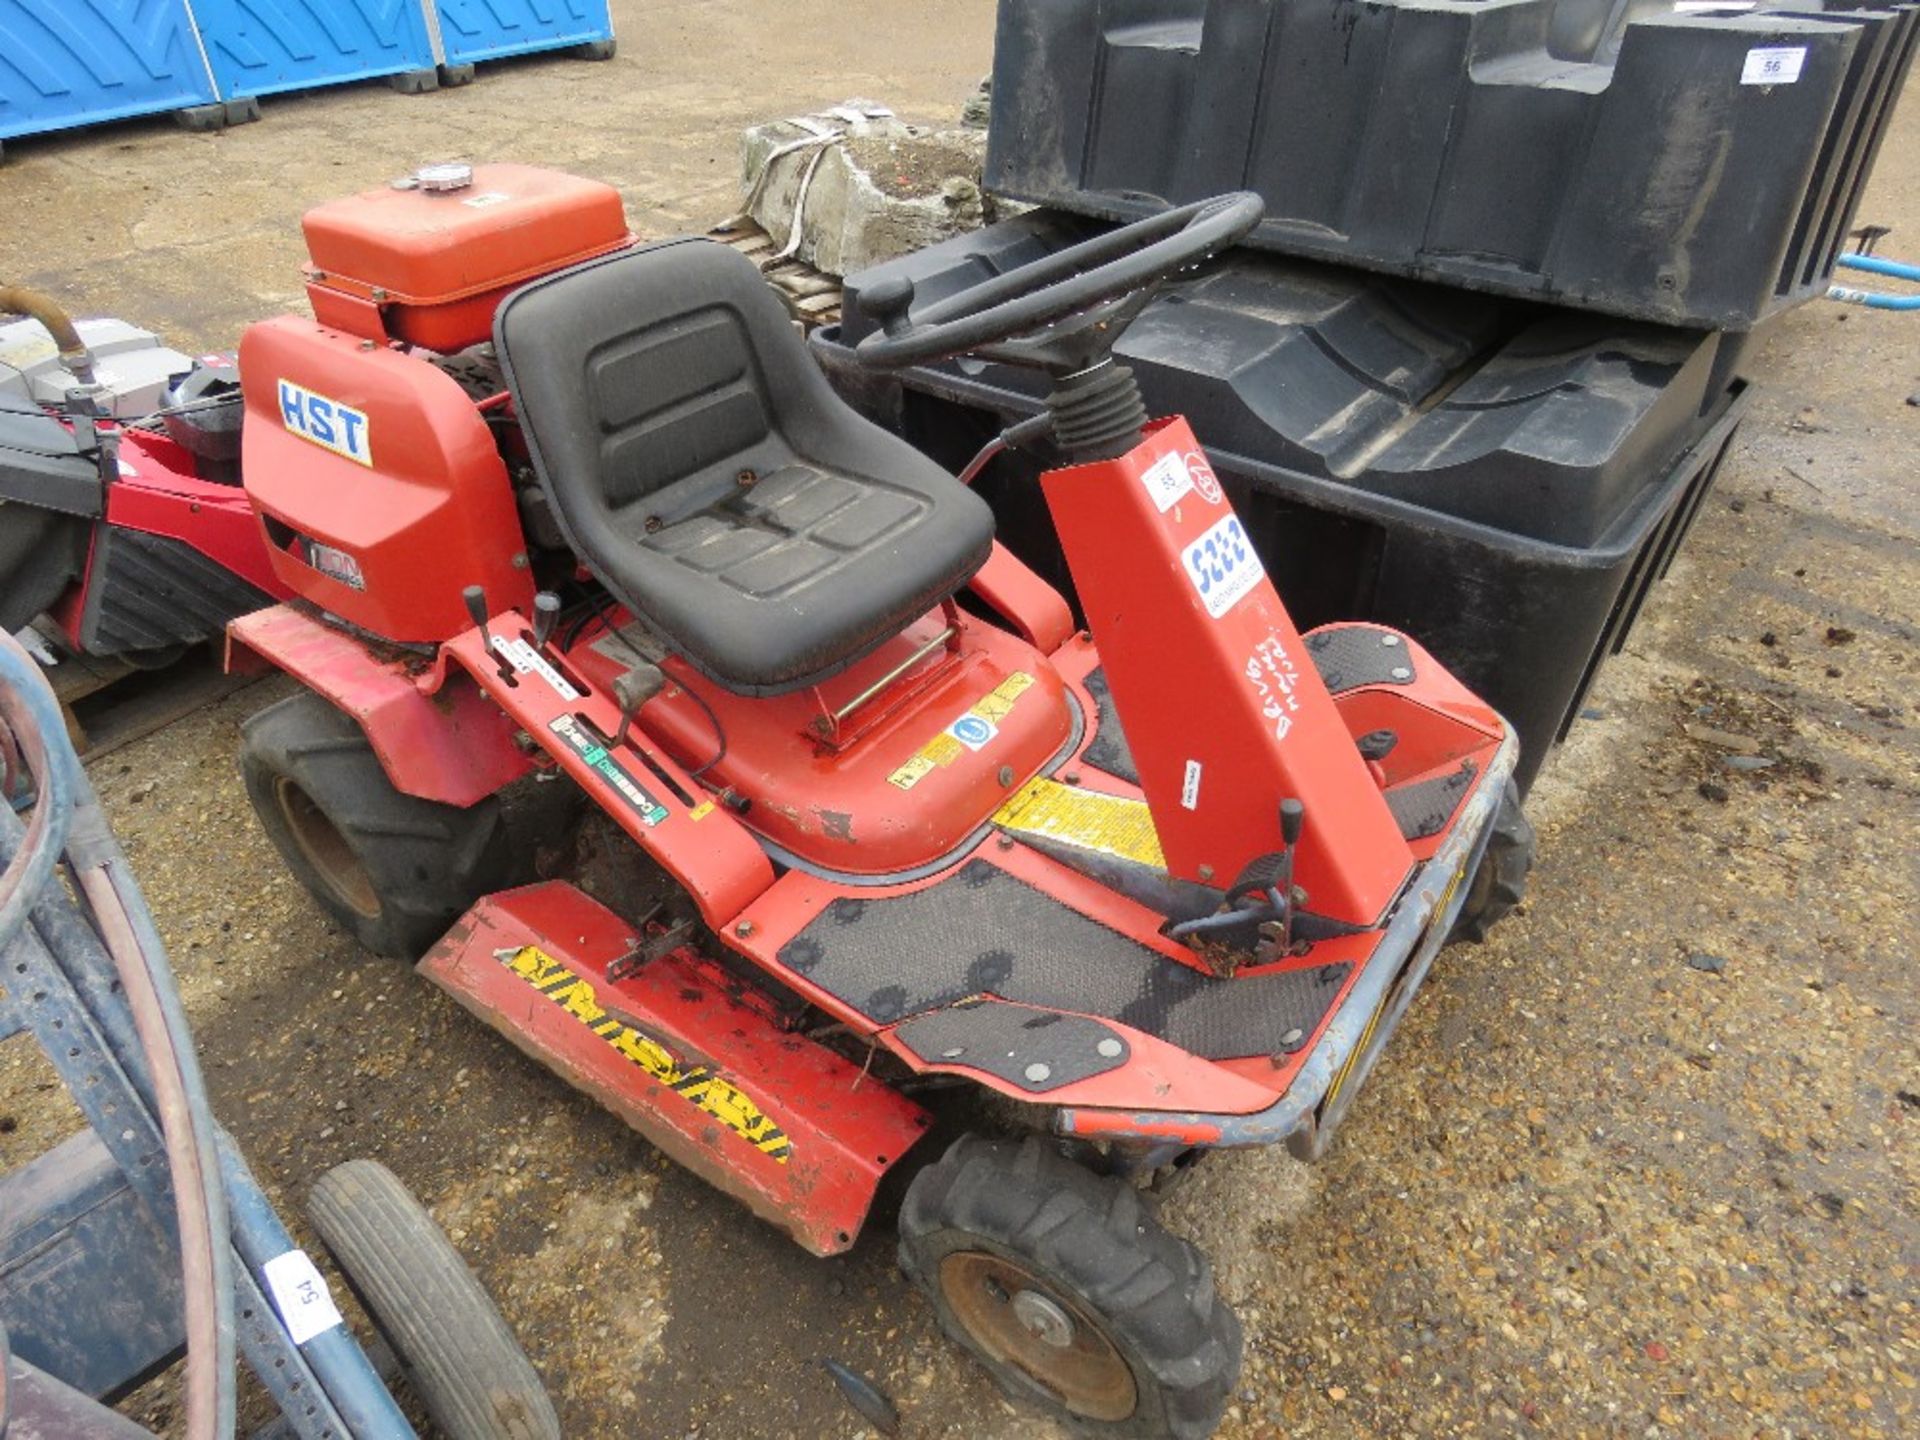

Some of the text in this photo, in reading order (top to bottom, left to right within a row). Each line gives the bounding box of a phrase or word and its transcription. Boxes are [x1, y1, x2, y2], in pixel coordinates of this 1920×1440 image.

[1763, 61, 1781, 72] 56
[281, 384, 362, 453] HST
[296, 1279, 320, 1305] 54
